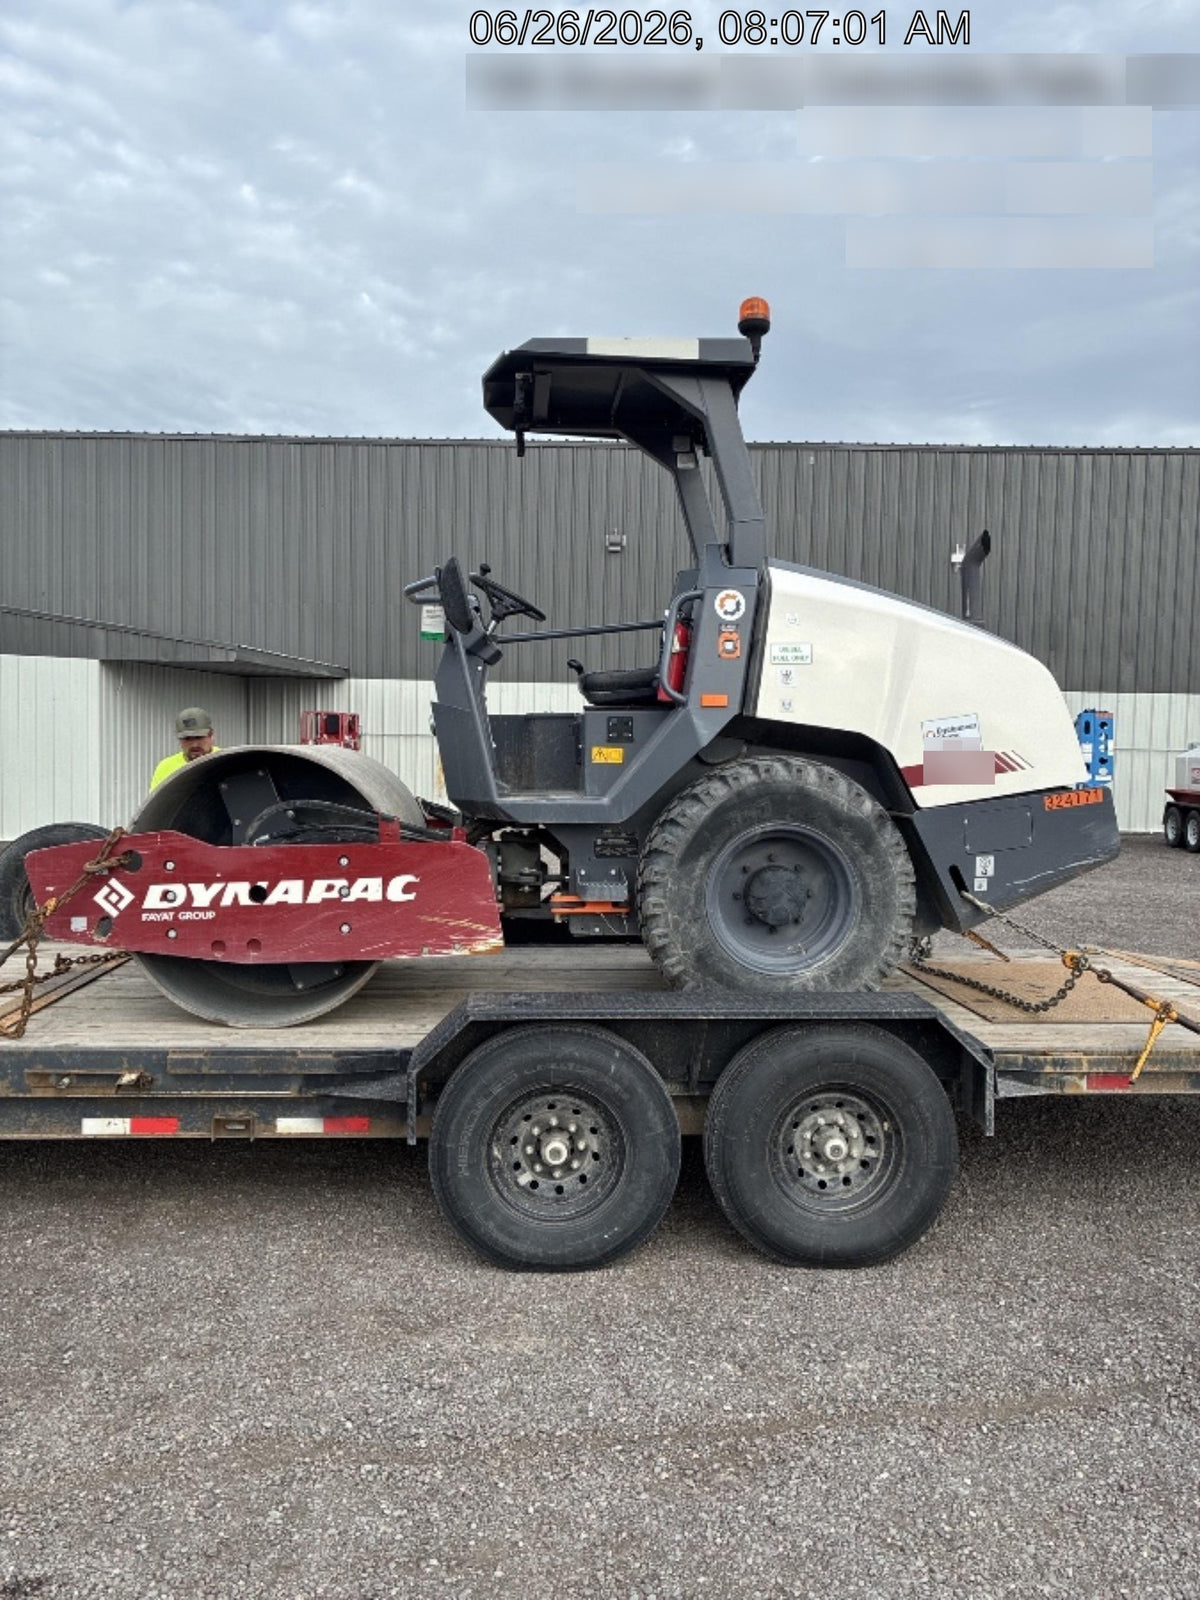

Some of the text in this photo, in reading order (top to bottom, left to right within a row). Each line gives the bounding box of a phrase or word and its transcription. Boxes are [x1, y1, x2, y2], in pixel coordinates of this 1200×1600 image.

[1046, 788, 1098, 808] 324171
[141, 874, 421, 909] DYNAPAC
[141, 911, 216, 922] FAYAT GROUP
